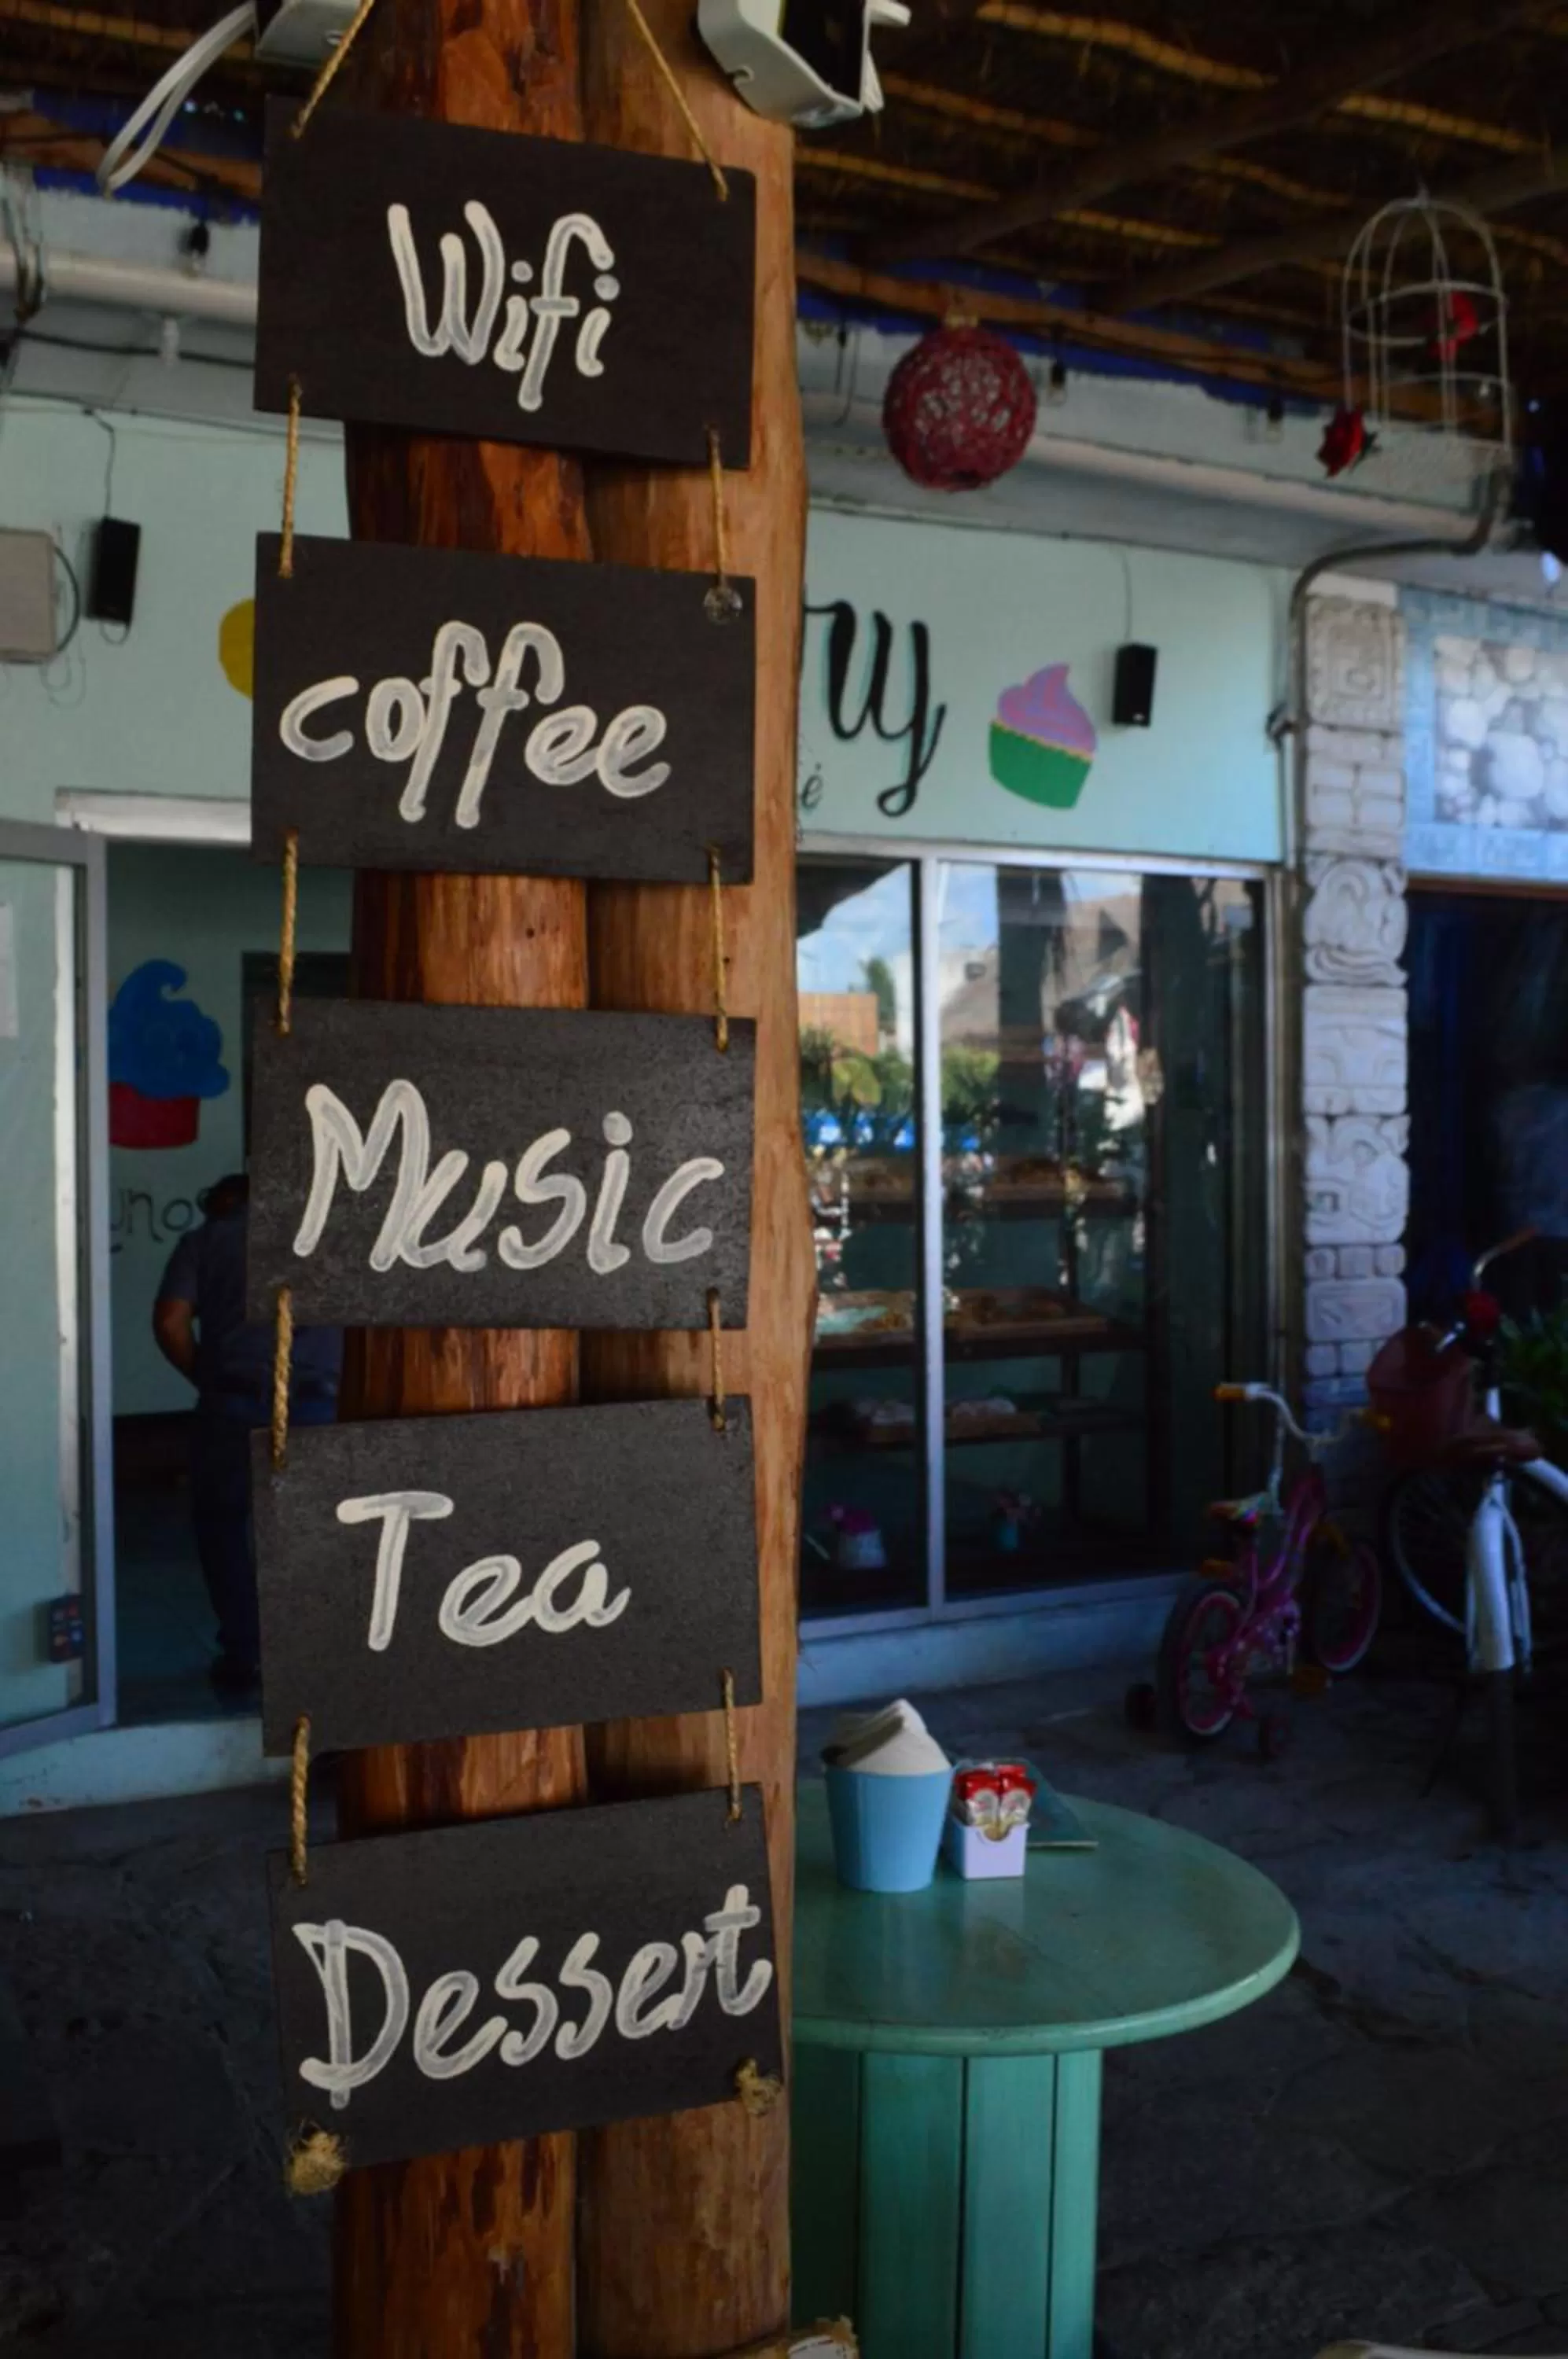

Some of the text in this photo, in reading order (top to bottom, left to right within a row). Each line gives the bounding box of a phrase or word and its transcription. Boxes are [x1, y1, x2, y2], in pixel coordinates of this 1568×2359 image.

[387, 200, 620, 412] Wifi
[279, 620, 671, 830] coffee
[293, 1078, 727, 1276] Music
[335, 1489, 632, 1652] Tea
[291, 1882, 775, 2110] Dessert
